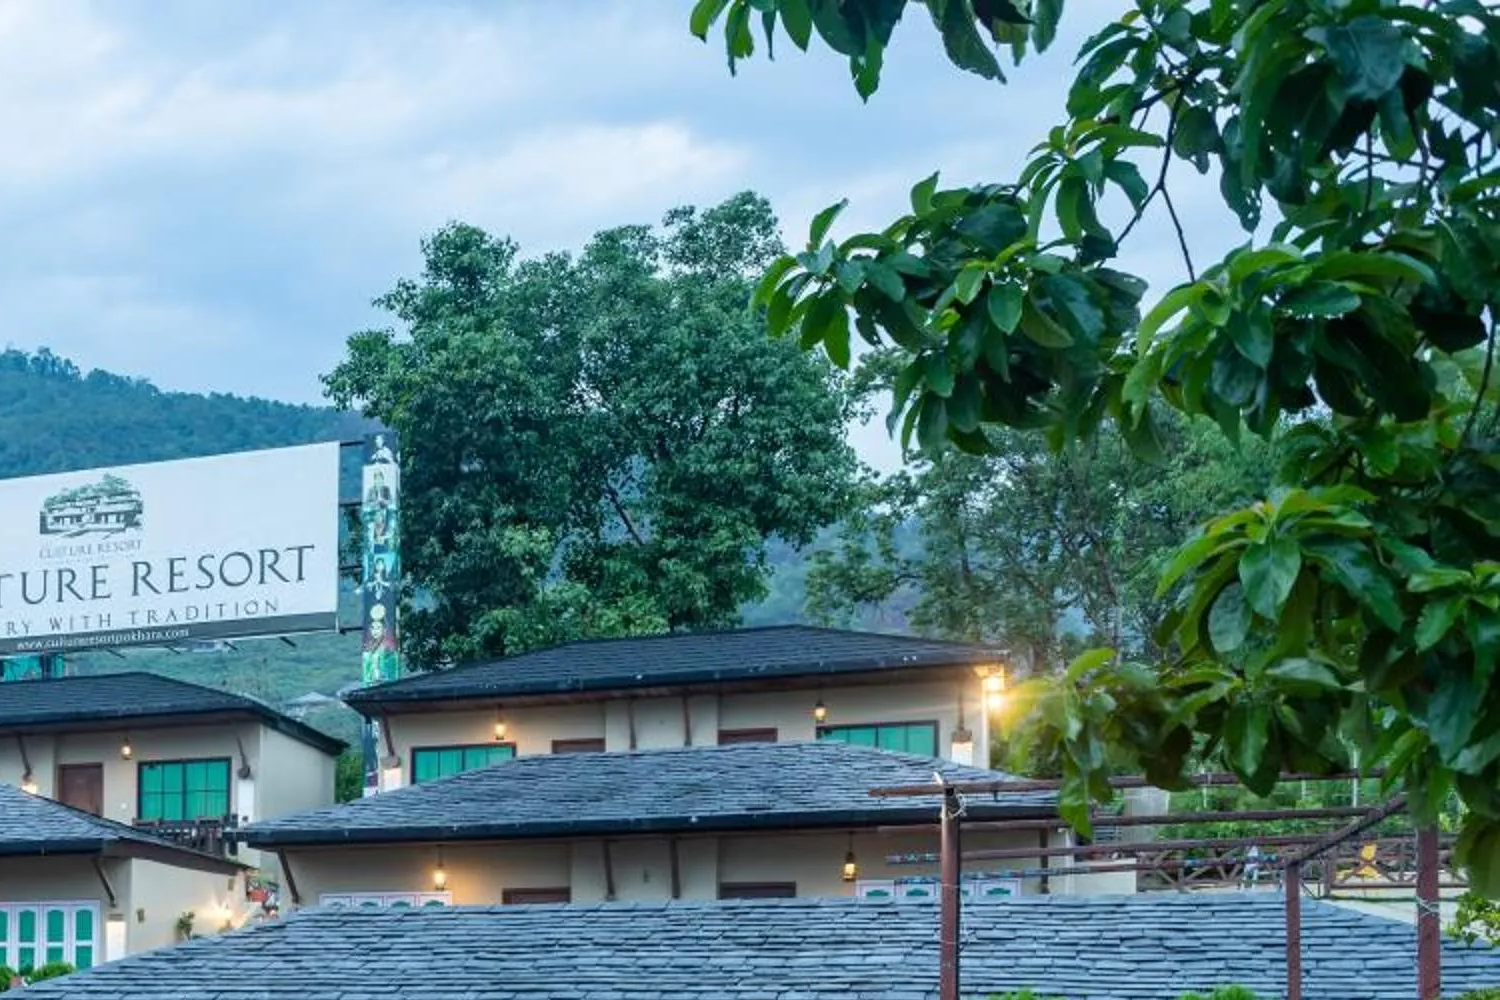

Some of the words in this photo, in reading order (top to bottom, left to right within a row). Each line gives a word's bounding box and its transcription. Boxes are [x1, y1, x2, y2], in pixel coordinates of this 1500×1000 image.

[97, 539, 142, 553] RESORT
[131, 544, 316, 597] RESORT
[49, 612, 112, 631] WITH
[129, 597, 279, 625] TRADITION
